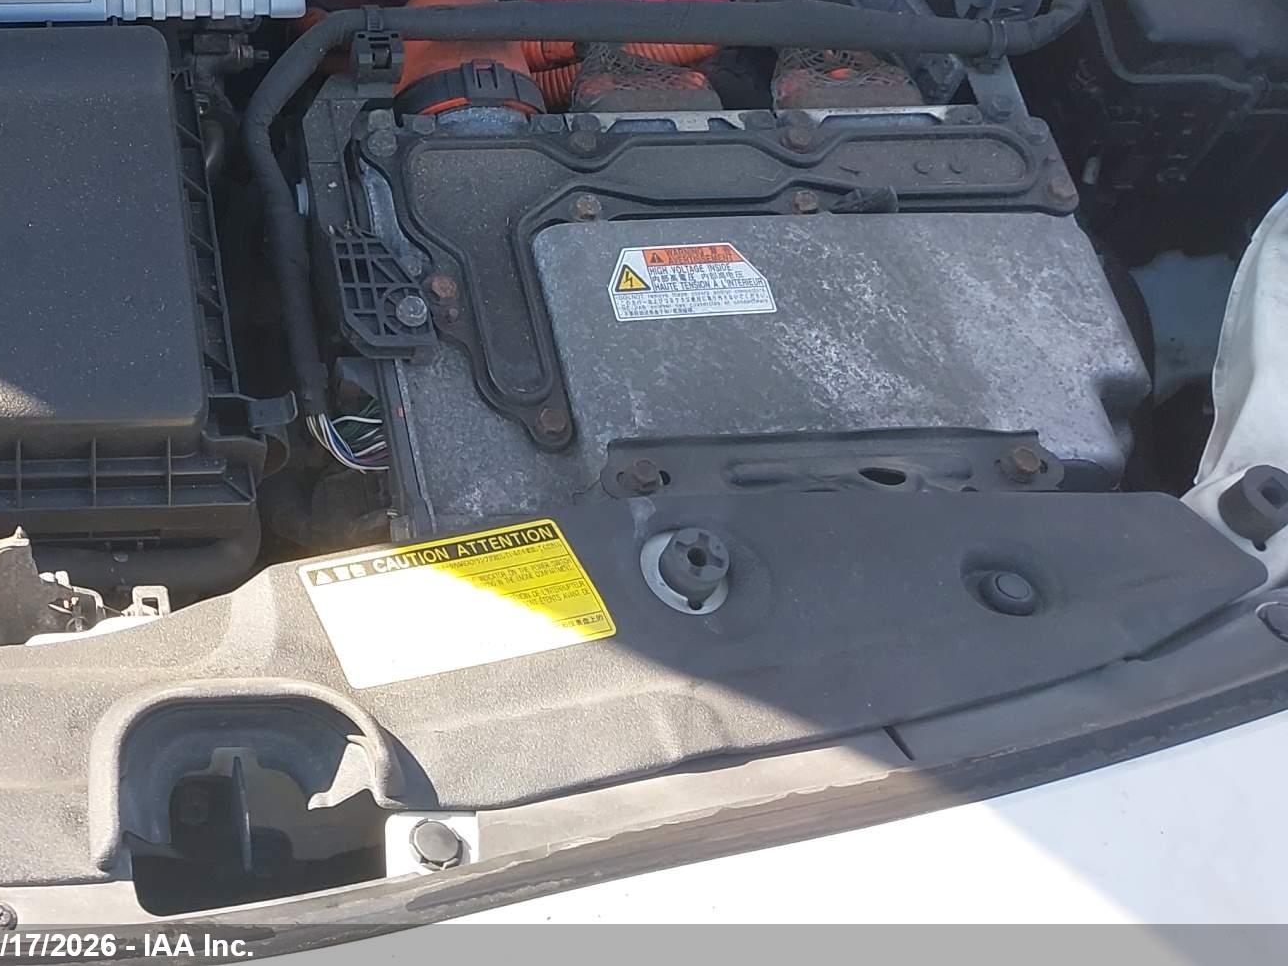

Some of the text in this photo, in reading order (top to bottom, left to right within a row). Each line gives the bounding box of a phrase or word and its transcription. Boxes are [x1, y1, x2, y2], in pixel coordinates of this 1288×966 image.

[649, 263, 733, 275] HIGH VOLTAGE INSIDE
[654, 282, 679, 292] HAUTE
[680, 280, 711, 291] TENSION
[372, 547, 450, 573] CAUTION
[455, 526, 554, 557] ATTENTION
